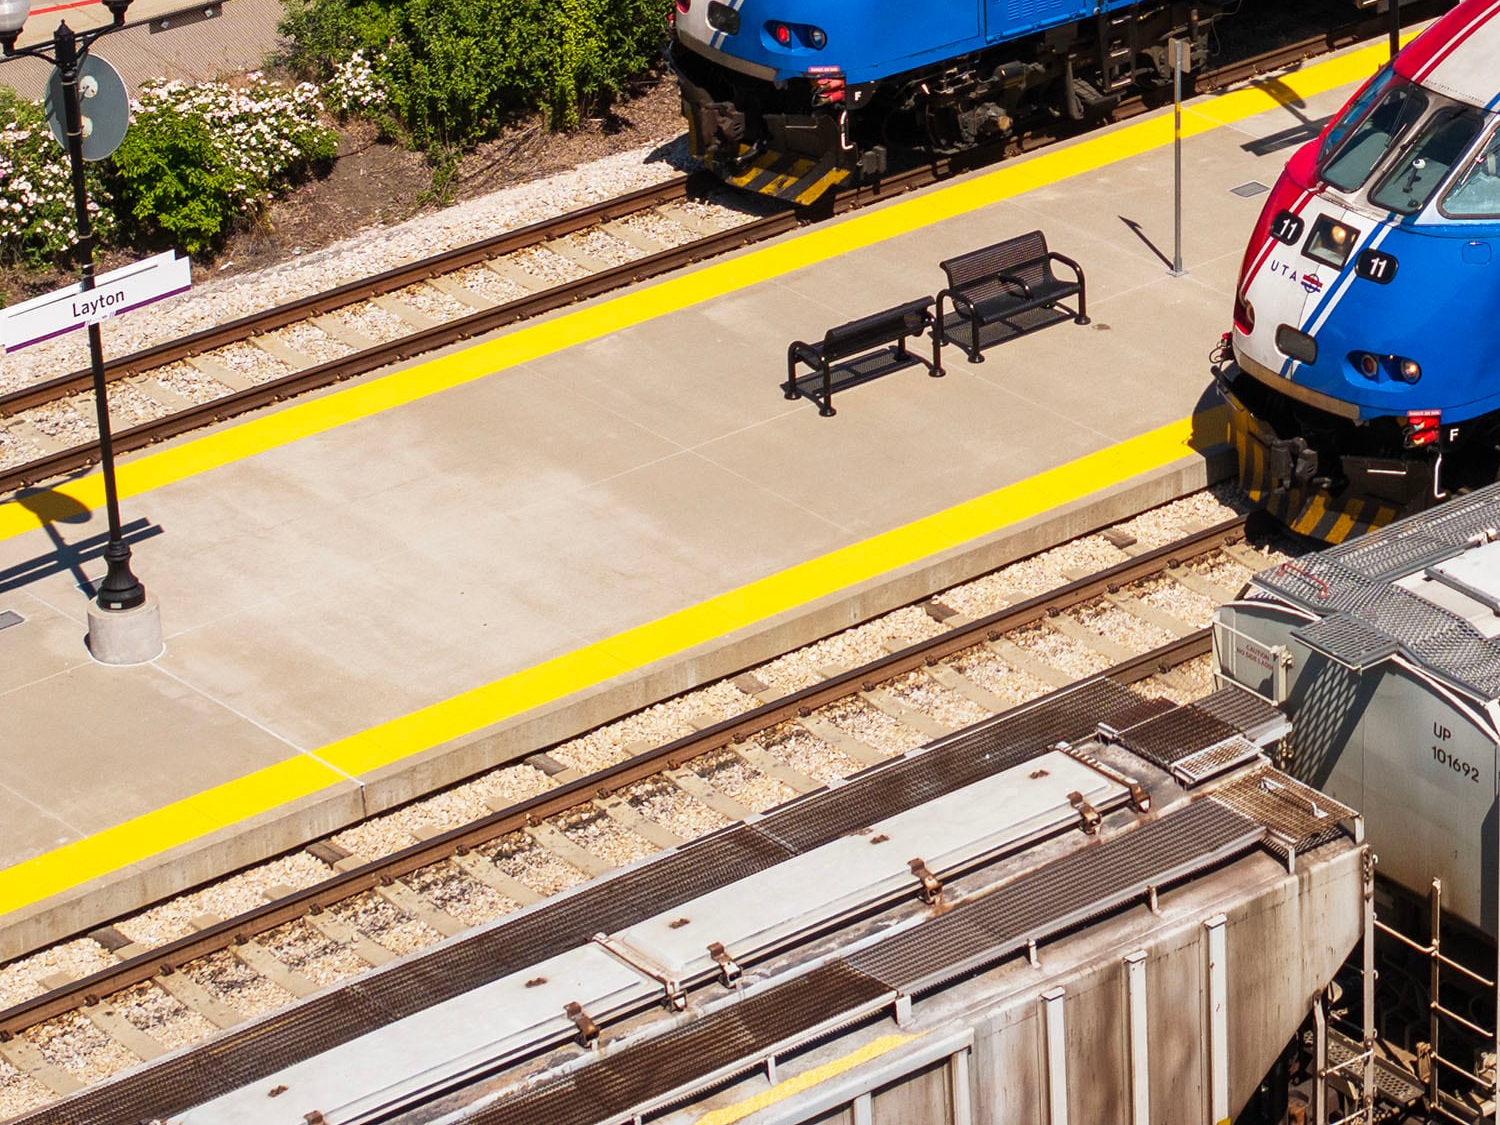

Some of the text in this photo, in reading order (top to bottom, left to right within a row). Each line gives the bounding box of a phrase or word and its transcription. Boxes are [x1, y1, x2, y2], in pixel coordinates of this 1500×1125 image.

[854, 90, 862, 101] F
[1279, 217, 1298, 240] 11
[1270, 259, 1298, 283] UTA
[1370, 256, 1387, 277] 11
[72, 290, 125, 317] Layton
[1449, 428, 1459, 442] F
[1433, 721, 1451, 741] UP
[1431, 745, 1479, 783] 101692
